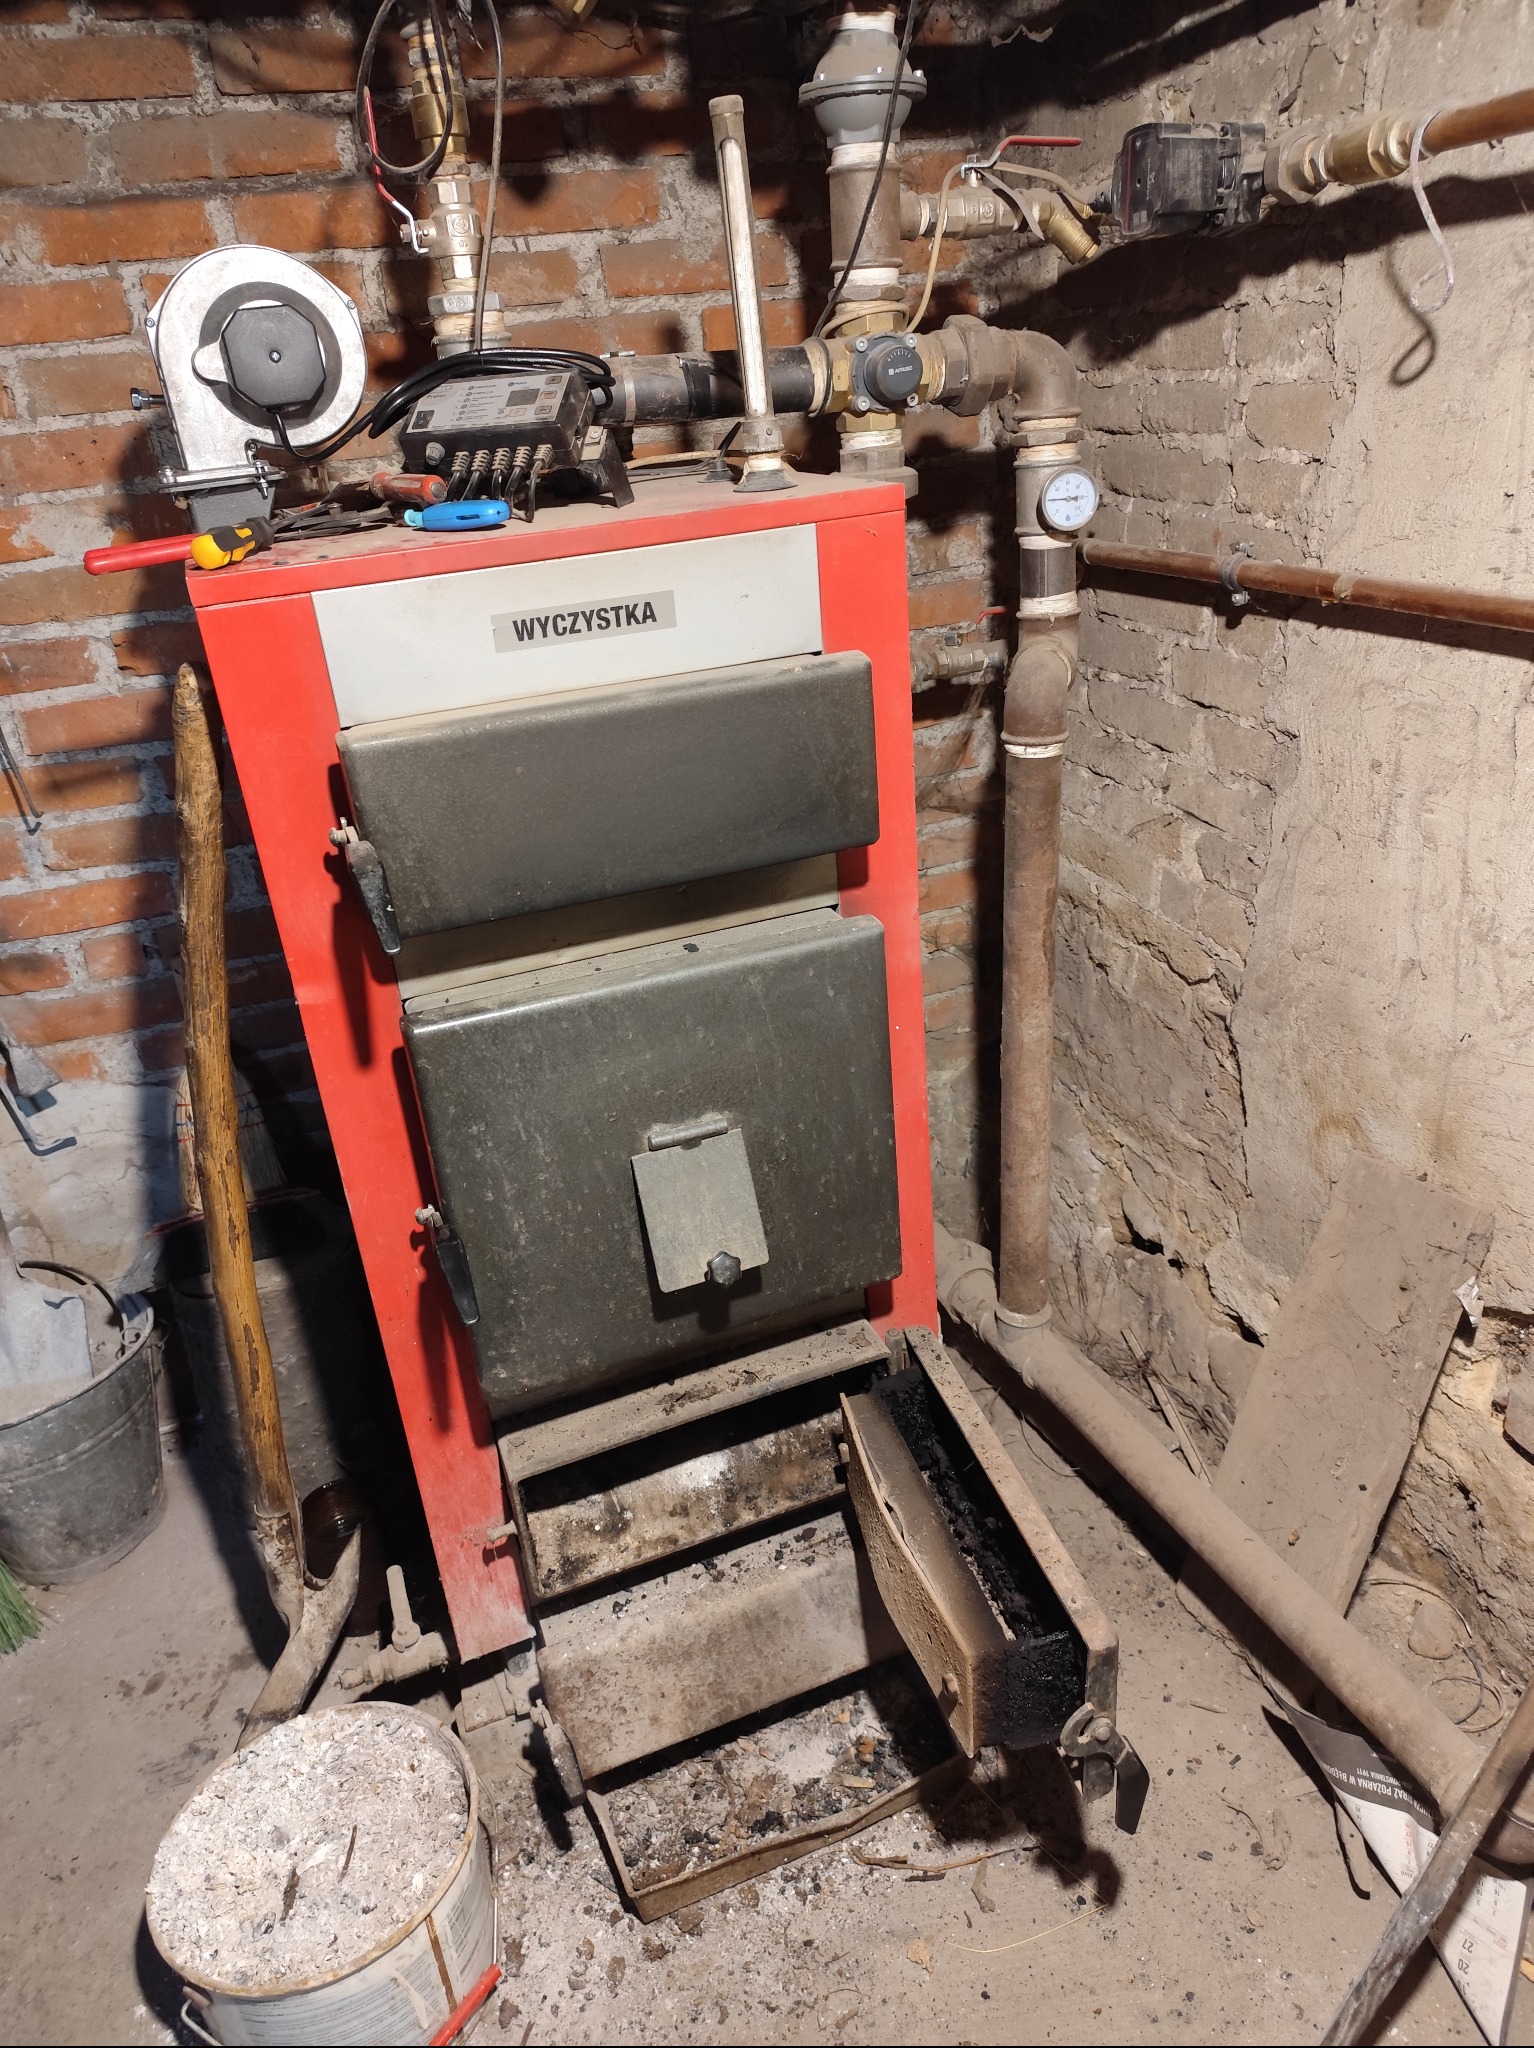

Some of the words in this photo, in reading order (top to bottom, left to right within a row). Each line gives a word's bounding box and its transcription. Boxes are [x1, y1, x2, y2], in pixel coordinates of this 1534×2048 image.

[512, 601, 657, 642] WYCZYSTKA
[1349, 1775, 1357, 1785] W
[1356, 1767, 1370, 1777] 1911
[1358, 1778, 1392, 1796] POŻARNA
[1461, 1938, 1474, 1954] 27
[1457, 1958, 1470, 1975] 20
